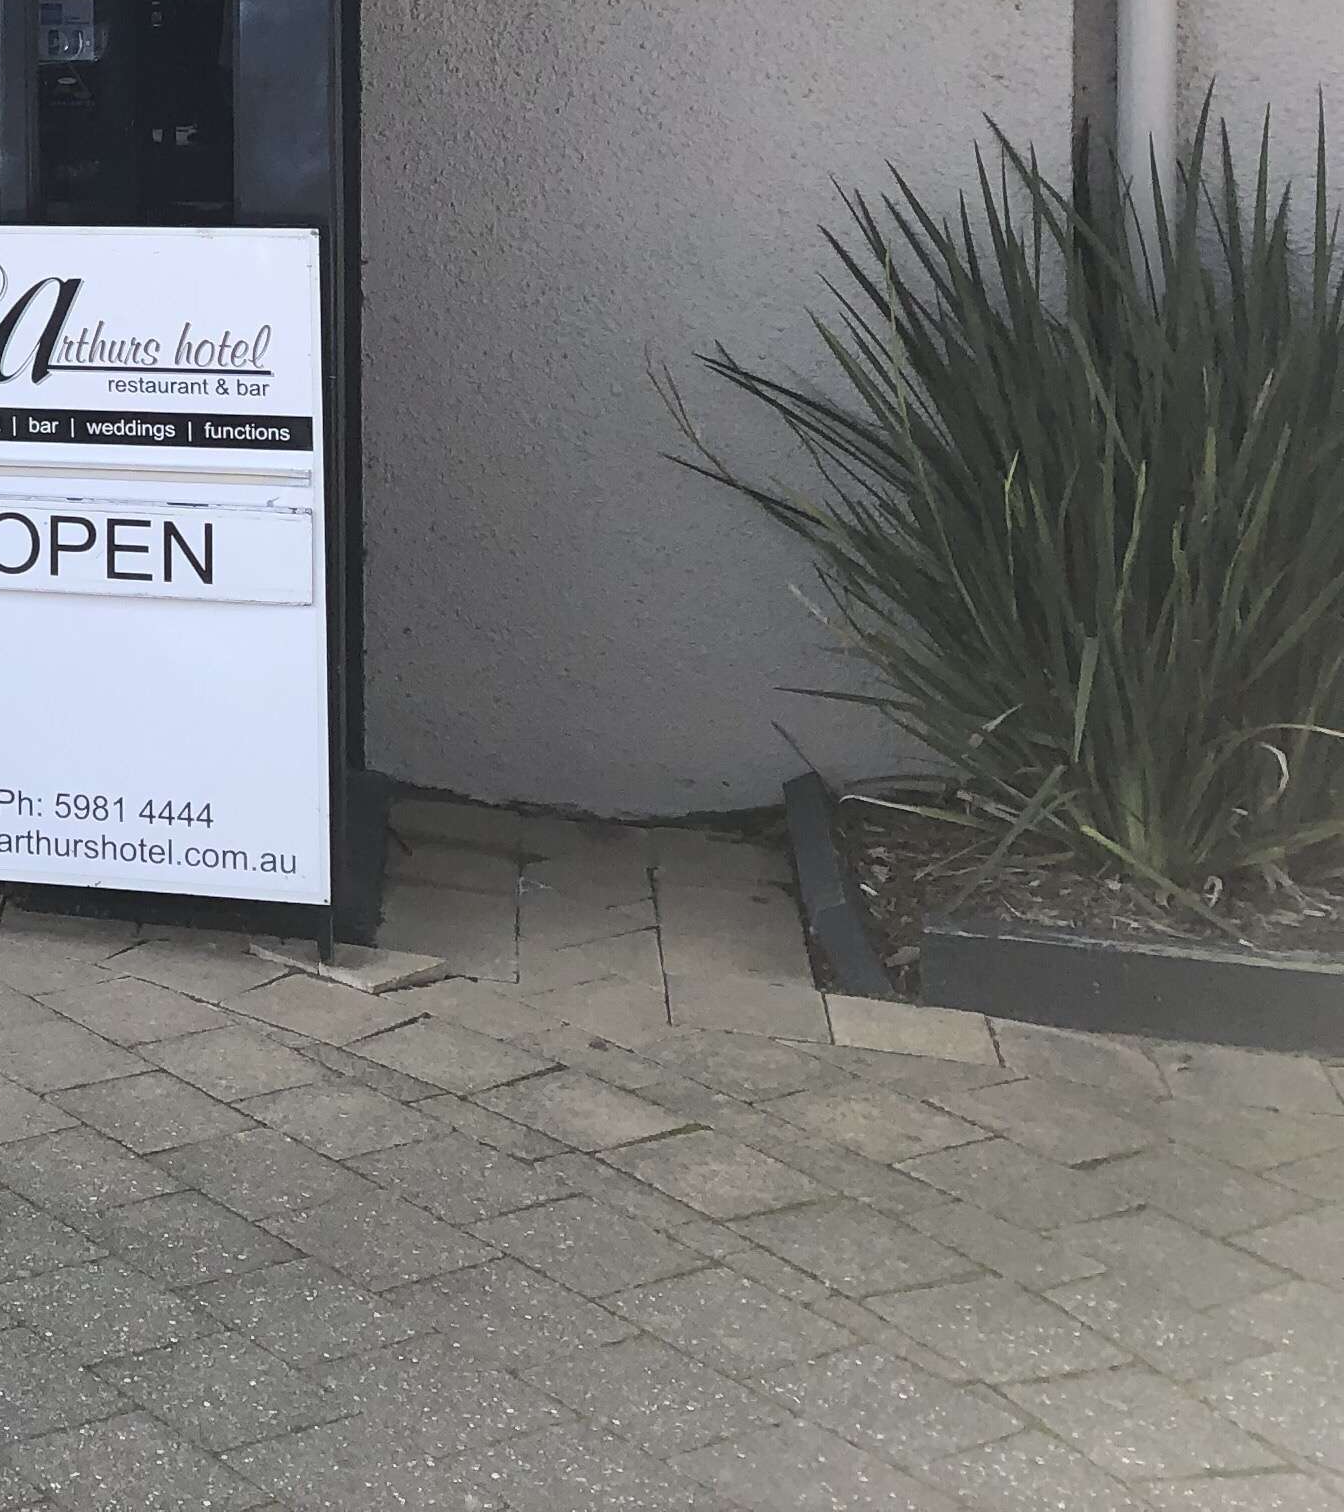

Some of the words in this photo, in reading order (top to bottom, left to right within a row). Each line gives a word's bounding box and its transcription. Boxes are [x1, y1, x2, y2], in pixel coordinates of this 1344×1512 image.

[174, 322, 273, 369] hotel
[107, 376, 210, 396] restaurant
[215, 378, 231, 396] &
[236, 378, 271, 397] bar
[28, 417, 60, 435] bar
[86, 419, 177, 440] weddings
[204, 422, 291, 442] functions
[55, 793, 125, 823] 5981
[138, 799, 215, 829] 4444
